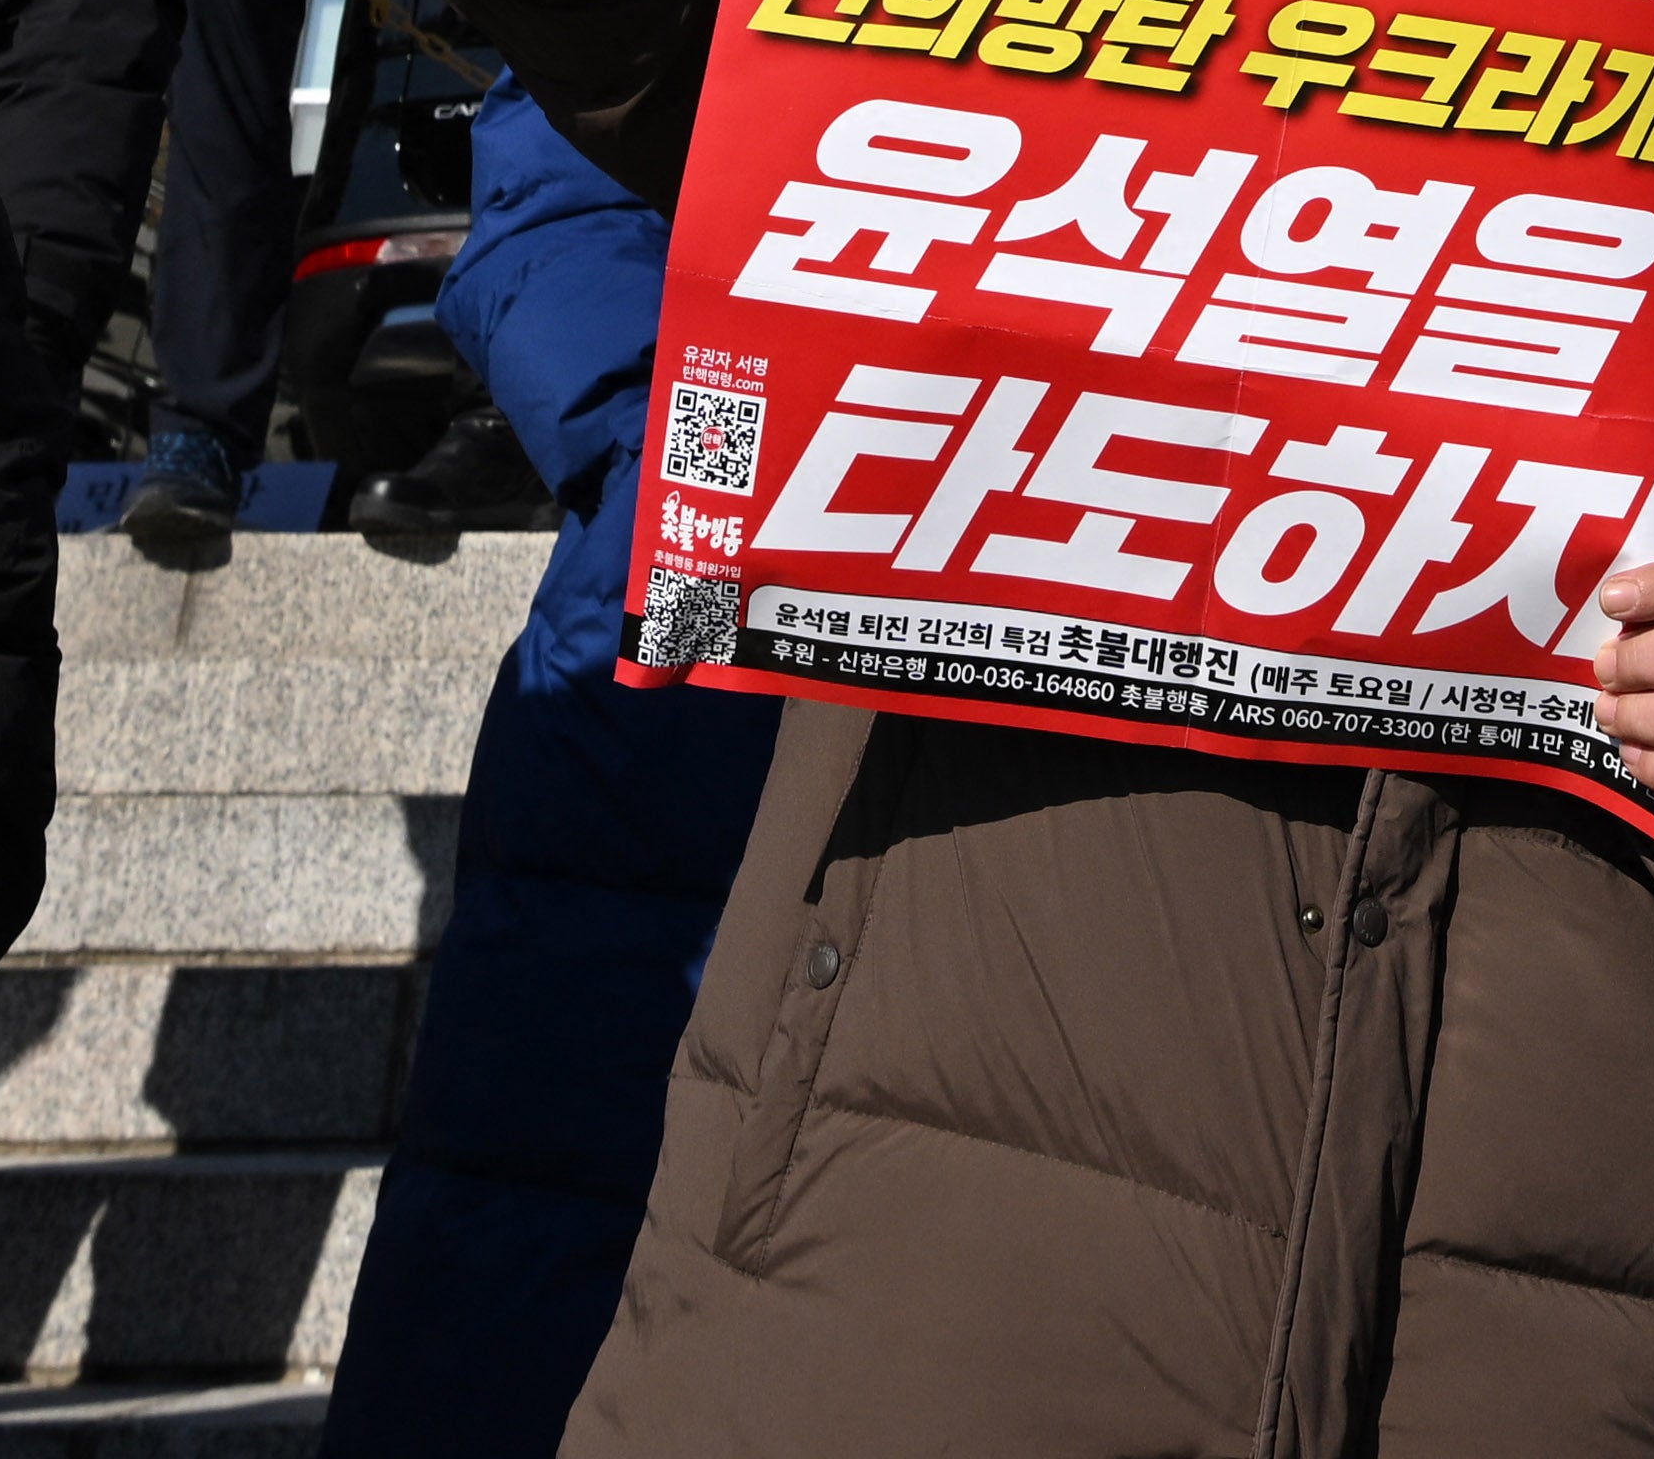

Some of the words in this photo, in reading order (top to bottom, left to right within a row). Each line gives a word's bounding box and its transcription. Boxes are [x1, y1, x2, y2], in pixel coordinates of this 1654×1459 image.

[682, 365, 765, 393] 탄핵명령.com
[683, 345, 732, 371] 유권자
[735, 354, 769, 376] 서명
[661, 497, 744, 557] 촛불행동
[653, 549, 694, 572] 촛불행동
[696, 558, 742, 579] 회원가입
[774, 602, 851, 634] 윤석열
[858, 612, 909, 642] 퇴진
[917, 619, 993, 650] 김건희
[1000, 625, 1050, 657] 특검
[1057, 624, 1237, 688] 촛불대행진
[1250, 662, 1319, 697] (매주
[1329, 672, 1413, 707] 토요일
[1420, 680, 1430, 711] /
[1441, 680, 1606, 738] 시청역-숭례
[771, 637, 816, 666] 후원
[837, 649, 927, 682] 신한은행
[933, 660, 1115, 703] 100-036-164860
[1120, 683, 1209, 717] 촛불행동
[1213, 697, 1225, 723] /
[1228, 701, 1276, 727] ARS
[1281, 708, 1435, 743] 060-707-3300
[1441, 720, 1472, 748] (한
[1477, 724, 1523, 750] 통에
[1528, 731, 1565, 755] 1만
[1569, 738, 1596, 771] 원,
